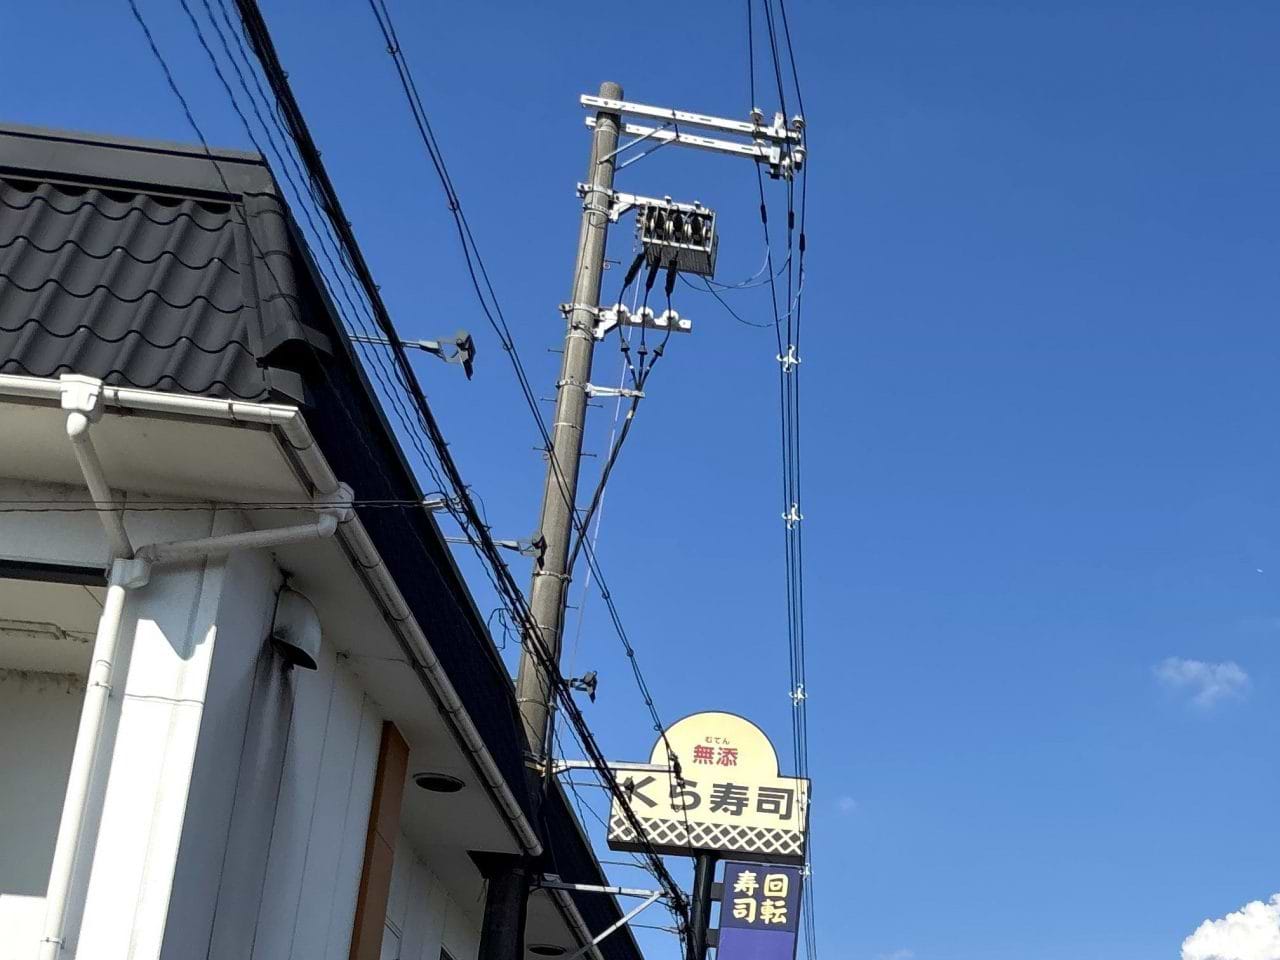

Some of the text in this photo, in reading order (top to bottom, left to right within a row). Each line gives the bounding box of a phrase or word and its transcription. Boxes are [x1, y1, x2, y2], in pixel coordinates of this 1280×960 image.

[693, 744, 738, 767] 無添
[620, 776, 794, 820] くら寿司
[732, 870, 759, 924] 寿司
[760, 873, 789, 924] 回転
